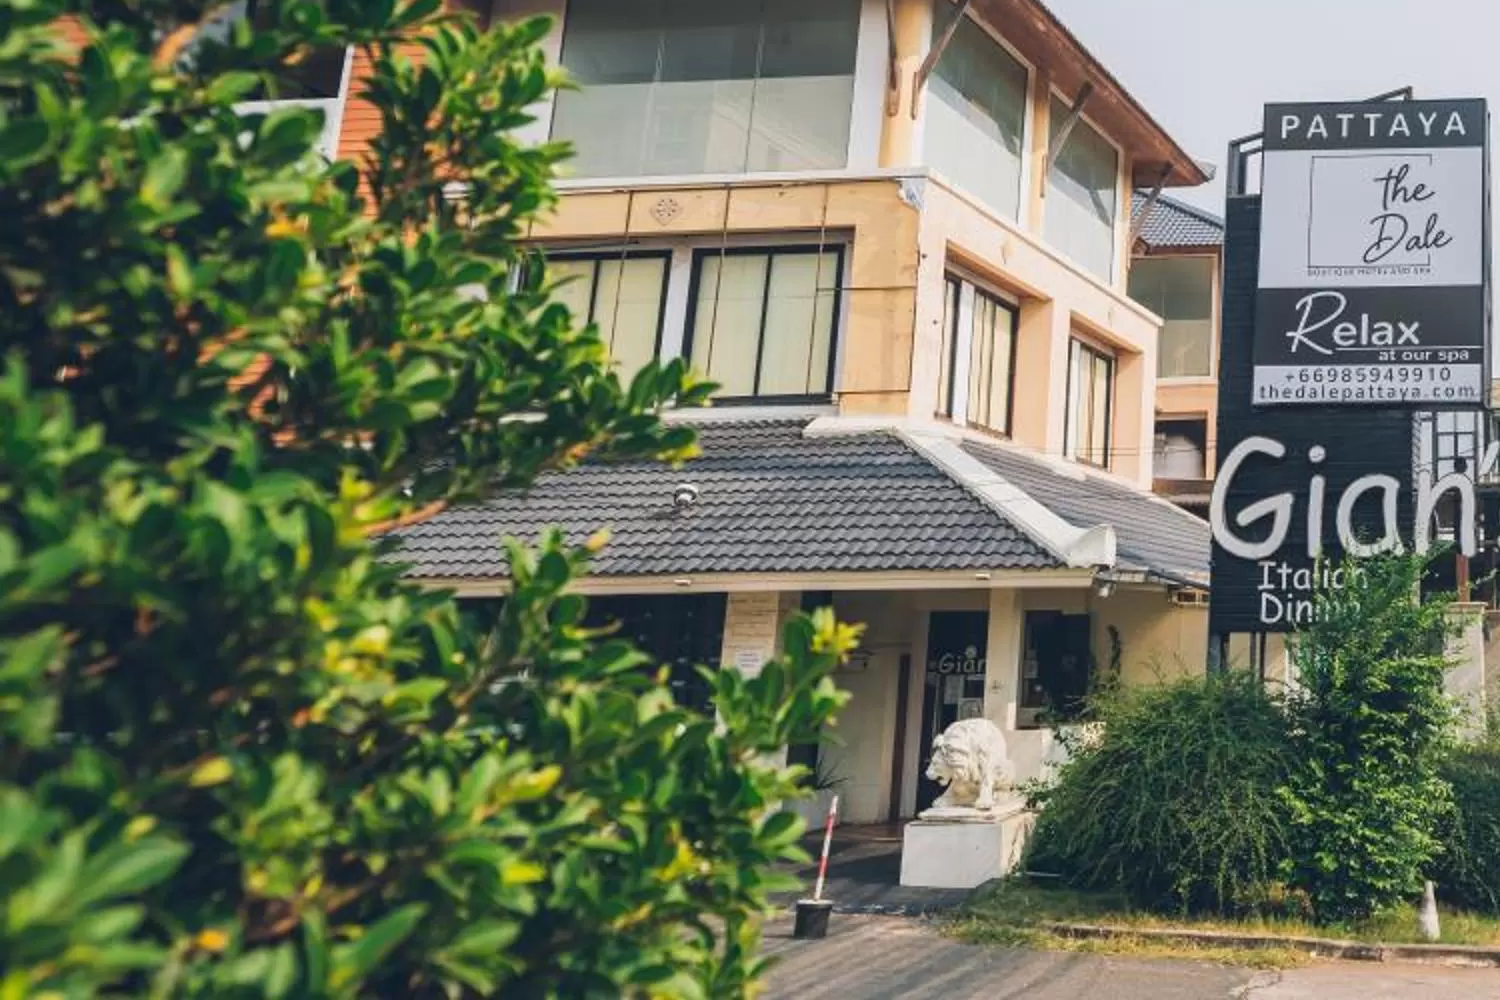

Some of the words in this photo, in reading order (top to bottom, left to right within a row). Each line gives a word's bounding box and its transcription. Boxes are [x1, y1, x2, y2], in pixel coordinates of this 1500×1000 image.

[1280, 111, 1466, 139] PATTAYA
[1374, 164, 1435, 210] the
[1363, 213, 1453, 264] Dale
[1286, 291, 1420, 354] Relax
[1379, 348, 1396, 361] at
[1402, 350, 1433, 361] our
[1438, 349, 1469, 363] spa
[1285, 366, 1452, 383] +66985949910
[1257, 561, 1368, 591] Itaian
